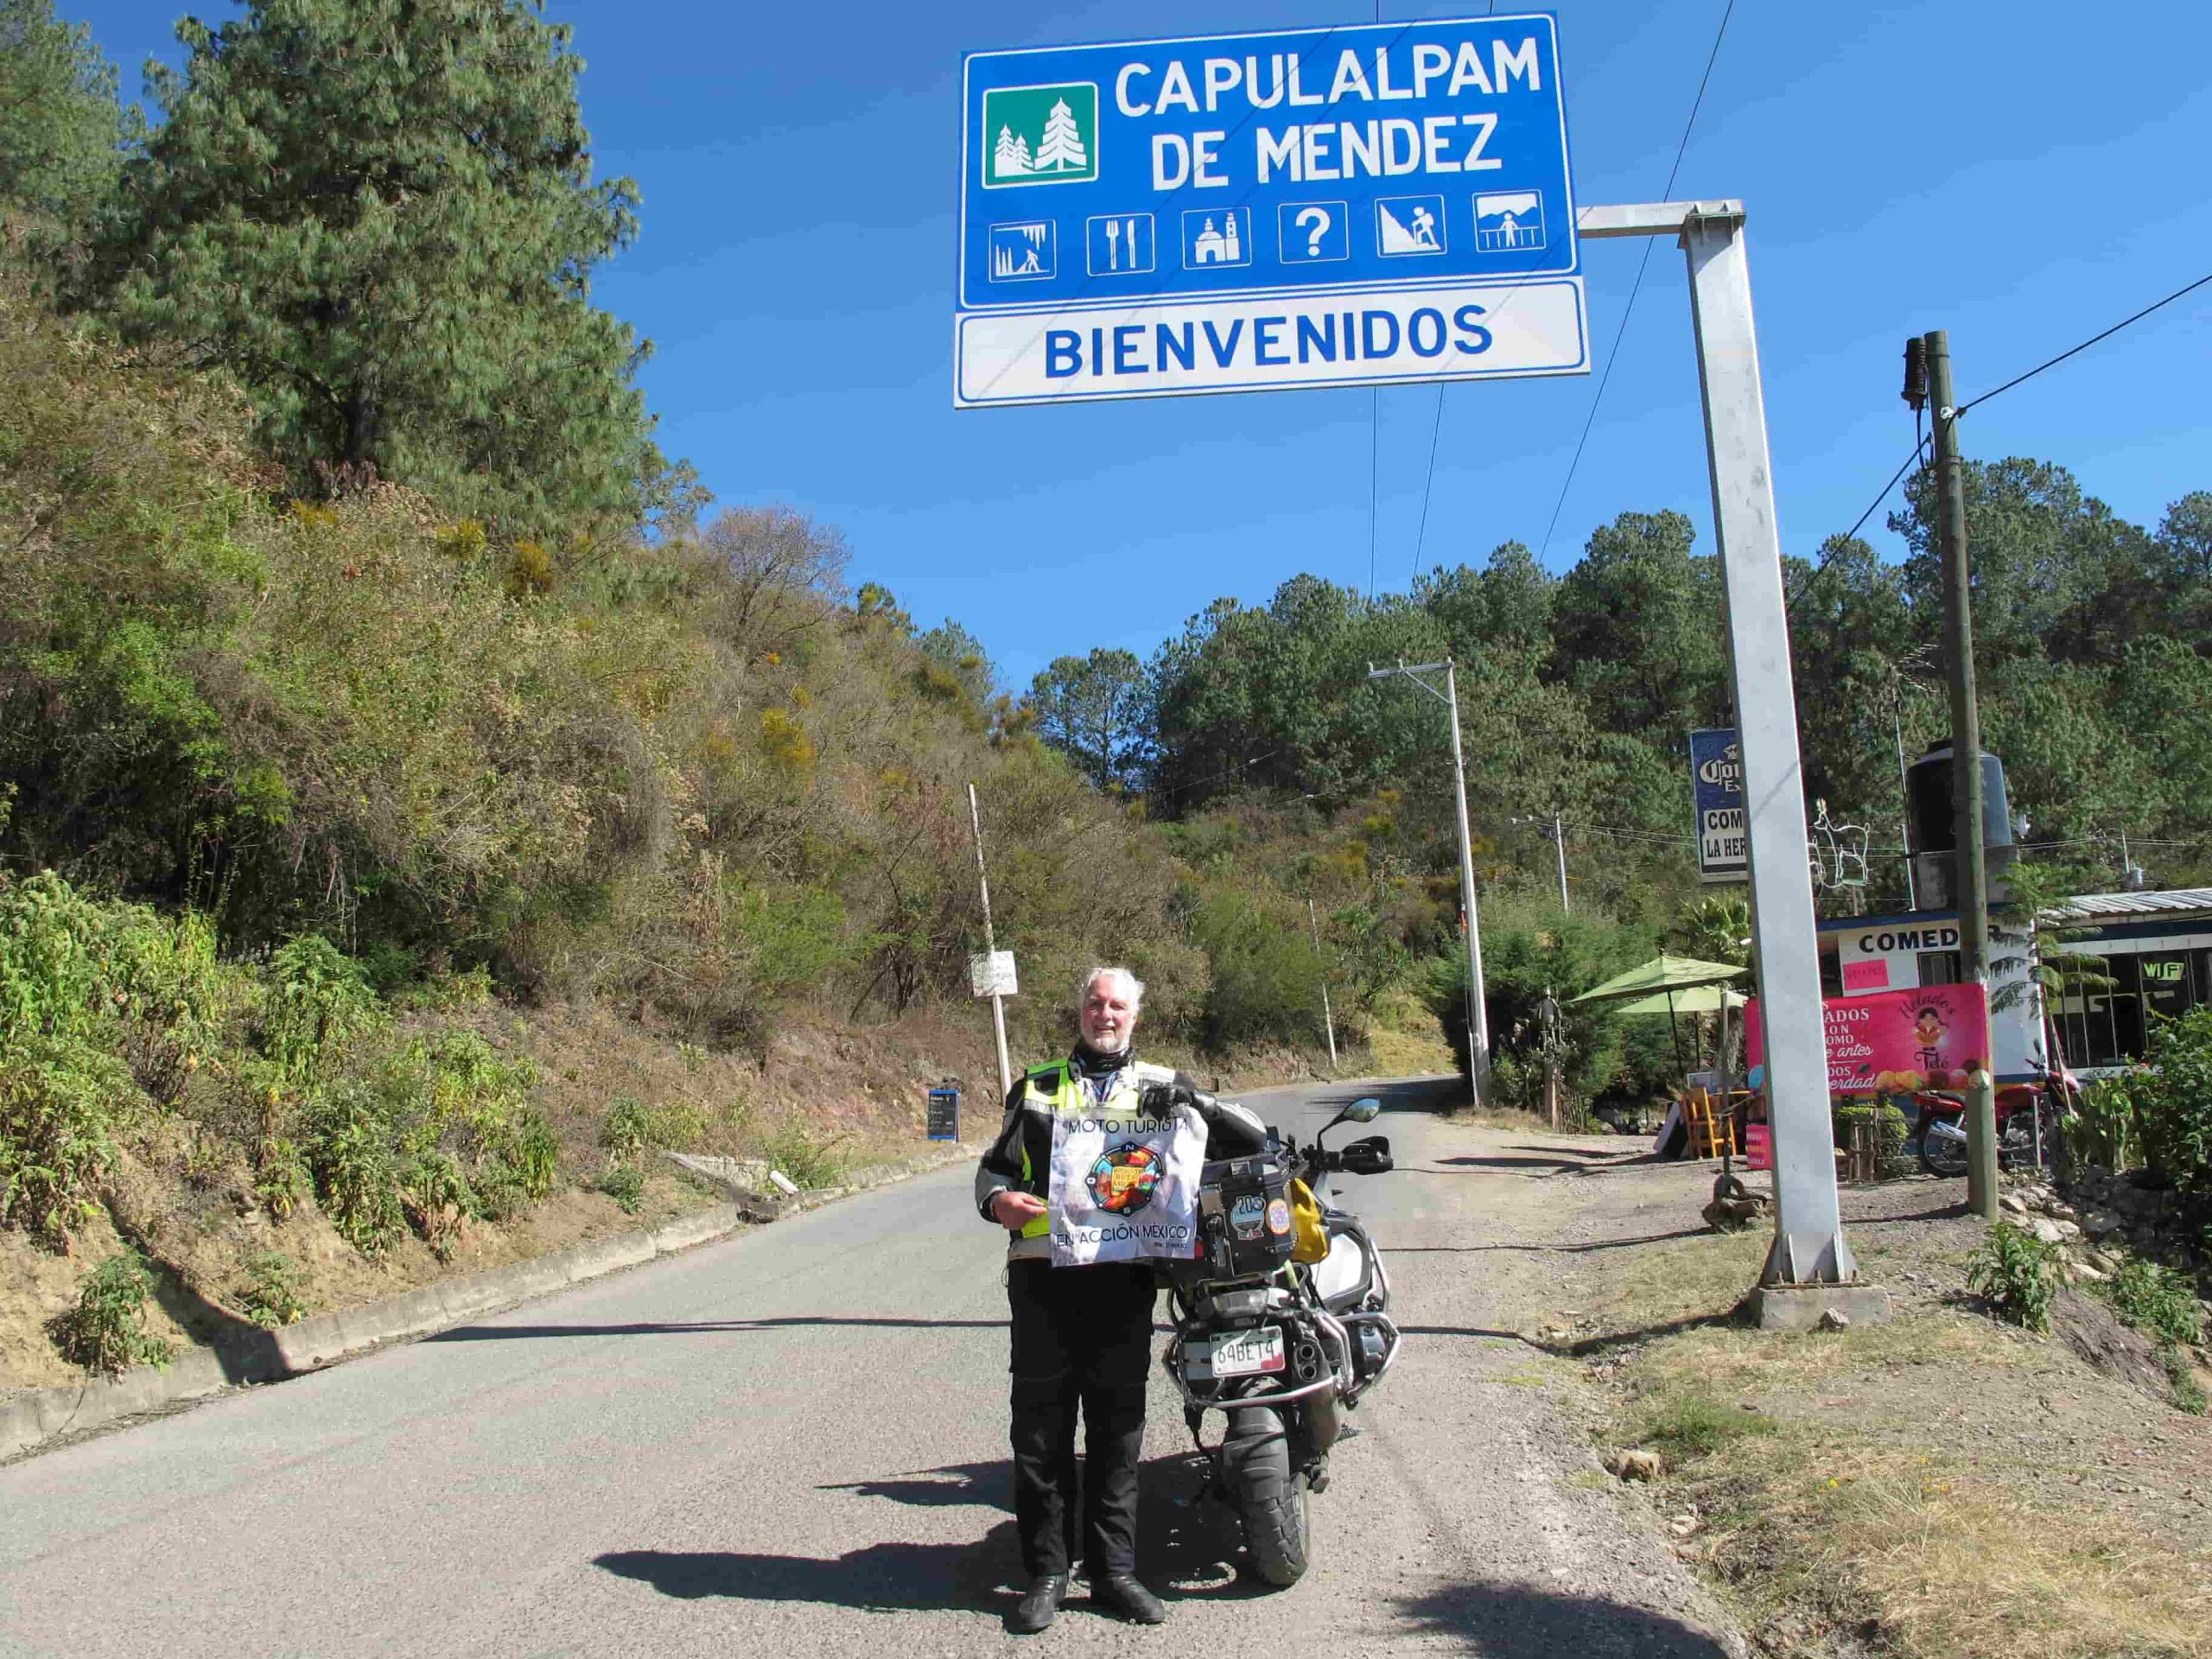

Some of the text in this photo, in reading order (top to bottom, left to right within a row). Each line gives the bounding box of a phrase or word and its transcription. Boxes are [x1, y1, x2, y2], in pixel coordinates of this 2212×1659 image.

[1115, 38, 1541, 118] CAPULALPAM
[1152, 113, 1502, 191] DE MENDEZ
[1045, 305, 1493, 378] BIENVENIDOS
[1708, 810, 1743, 830] COM
[1707, 837, 1745, 858] LA HER
[1859, 925, 2001, 953] COMEDR
[1825, 1008, 1870, 1023] ADOS
[1826, 1024, 1849, 1035] ON
[1826, 1034, 1854, 1045] OMO
[1837, 1044, 1874, 1058] antes
[1828, 1065, 1852, 1077] DOS
[1828, 1072, 1877, 1090] erdad
[1068, 1116, 1188, 1135] MOTO TURISTA
[1057, 1233, 1075, 1248] EN
[1079, 1223, 1140, 1244] ACCIÓN
[1217, 1339, 1274, 1363] 64BET4
